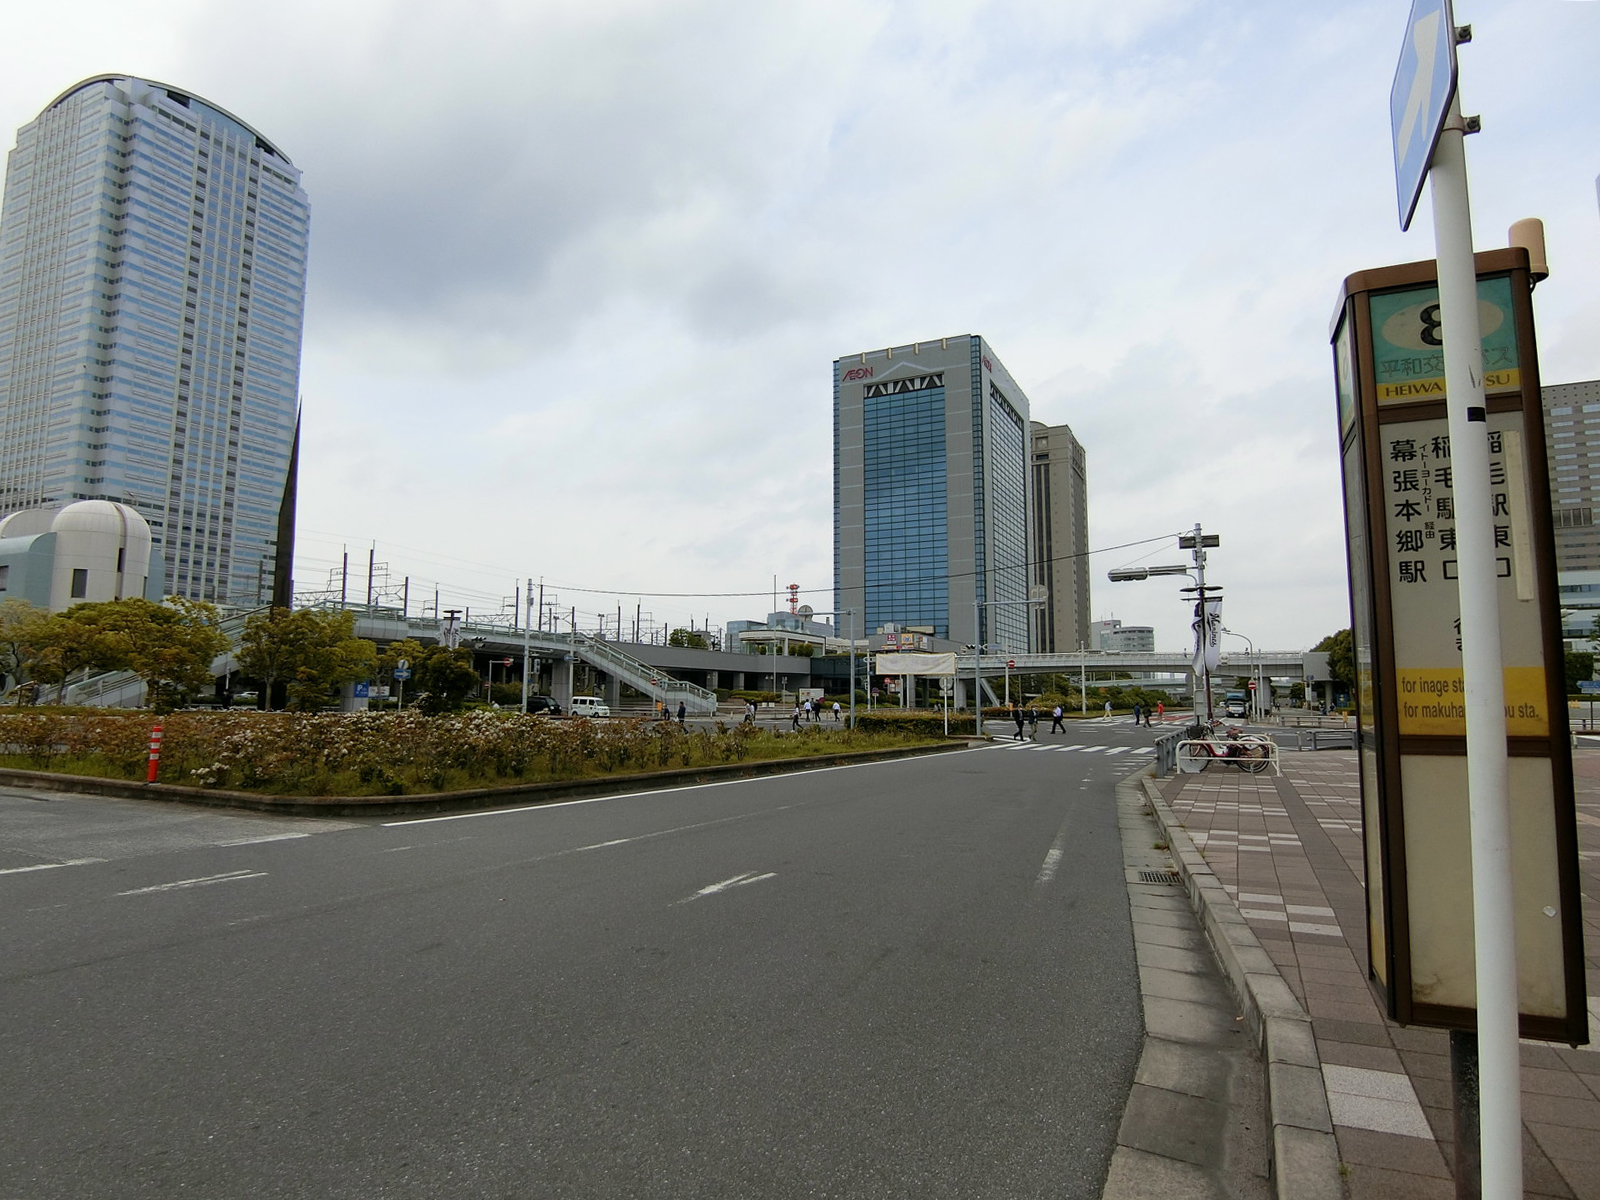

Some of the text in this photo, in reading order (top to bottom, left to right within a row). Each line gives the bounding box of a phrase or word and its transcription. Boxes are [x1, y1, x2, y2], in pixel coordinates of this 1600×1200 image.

[1385, 381, 1443, 397] HEIWA
[1390, 438, 1427, 583] 幕張本郷駅
[1402, 677, 1416, 693] for
[1420, 677, 1449, 697] inage
[1404, 702, 1418, 718] for
[1422, 702, 1465, 718] makuha
[1518, 703, 1539, 718] sta.
